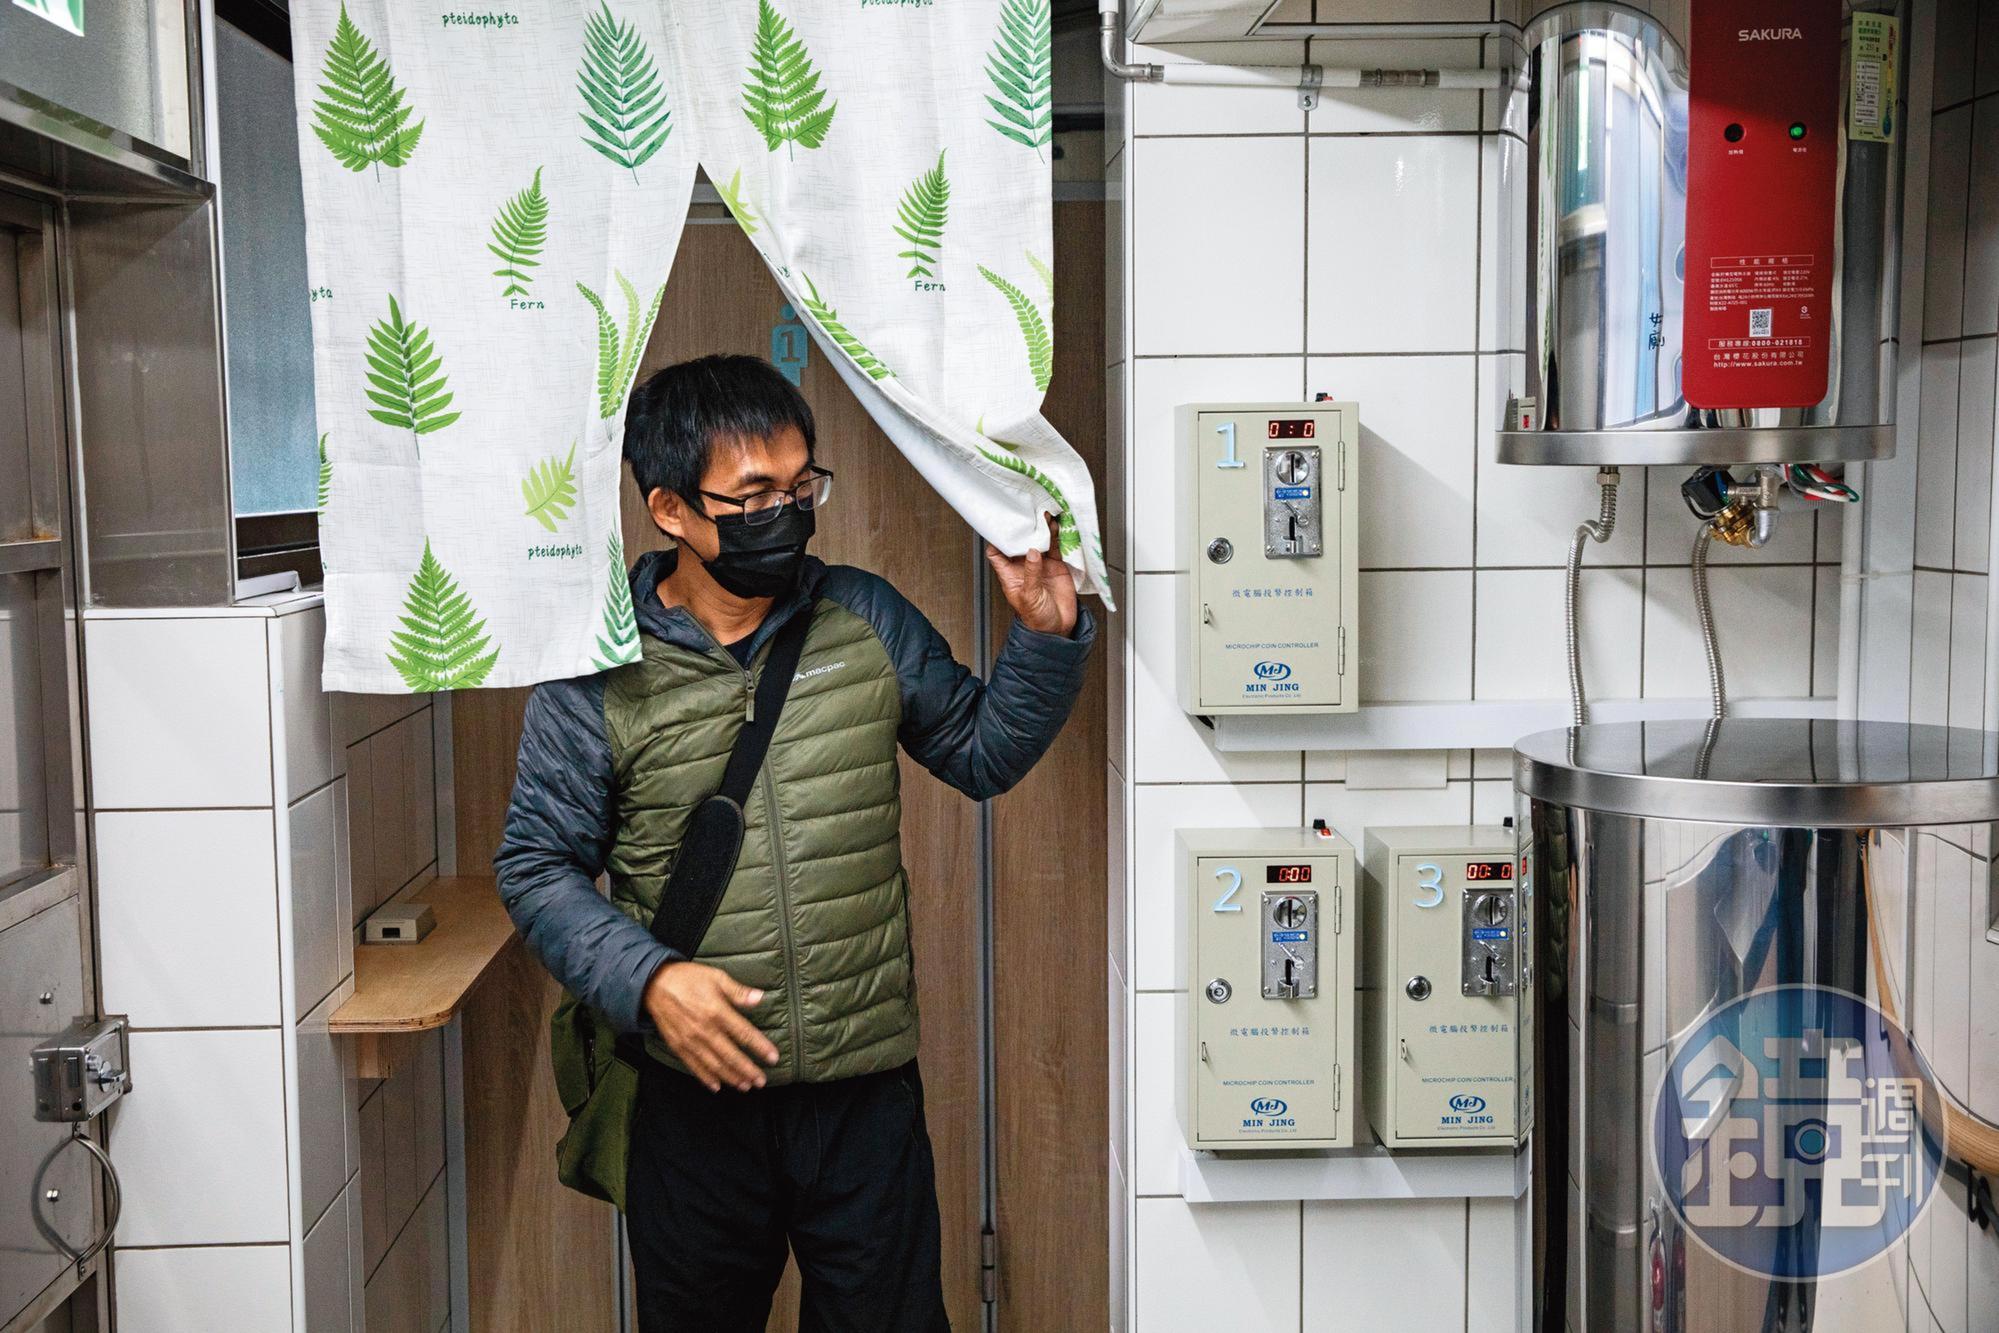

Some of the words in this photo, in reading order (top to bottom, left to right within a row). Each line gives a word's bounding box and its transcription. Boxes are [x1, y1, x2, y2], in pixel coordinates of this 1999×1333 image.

[442, 11, 519, 28] pteidophyta
[1738, 28, 1802, 41] SAKURA
[915, 280, 946, 291] Fern
[511, 299, 544, 310] Fern
[781, 330, 800, 363] 1
[1215, 422, 1246, 469] 1
[805, 661, 846, 677] macpac
[1246, 684, 1267, 692] MIN
[1272, 683, 1299, 691] JING
[1213, 865, 1244, 913] 2
[1413, 863, 1446, 908] 3
[1269, 1119, 1296, 1127] JING
[1441, 1116, 1462, 1124] MIN
[1467, 1115, 1494, 1124] JING
